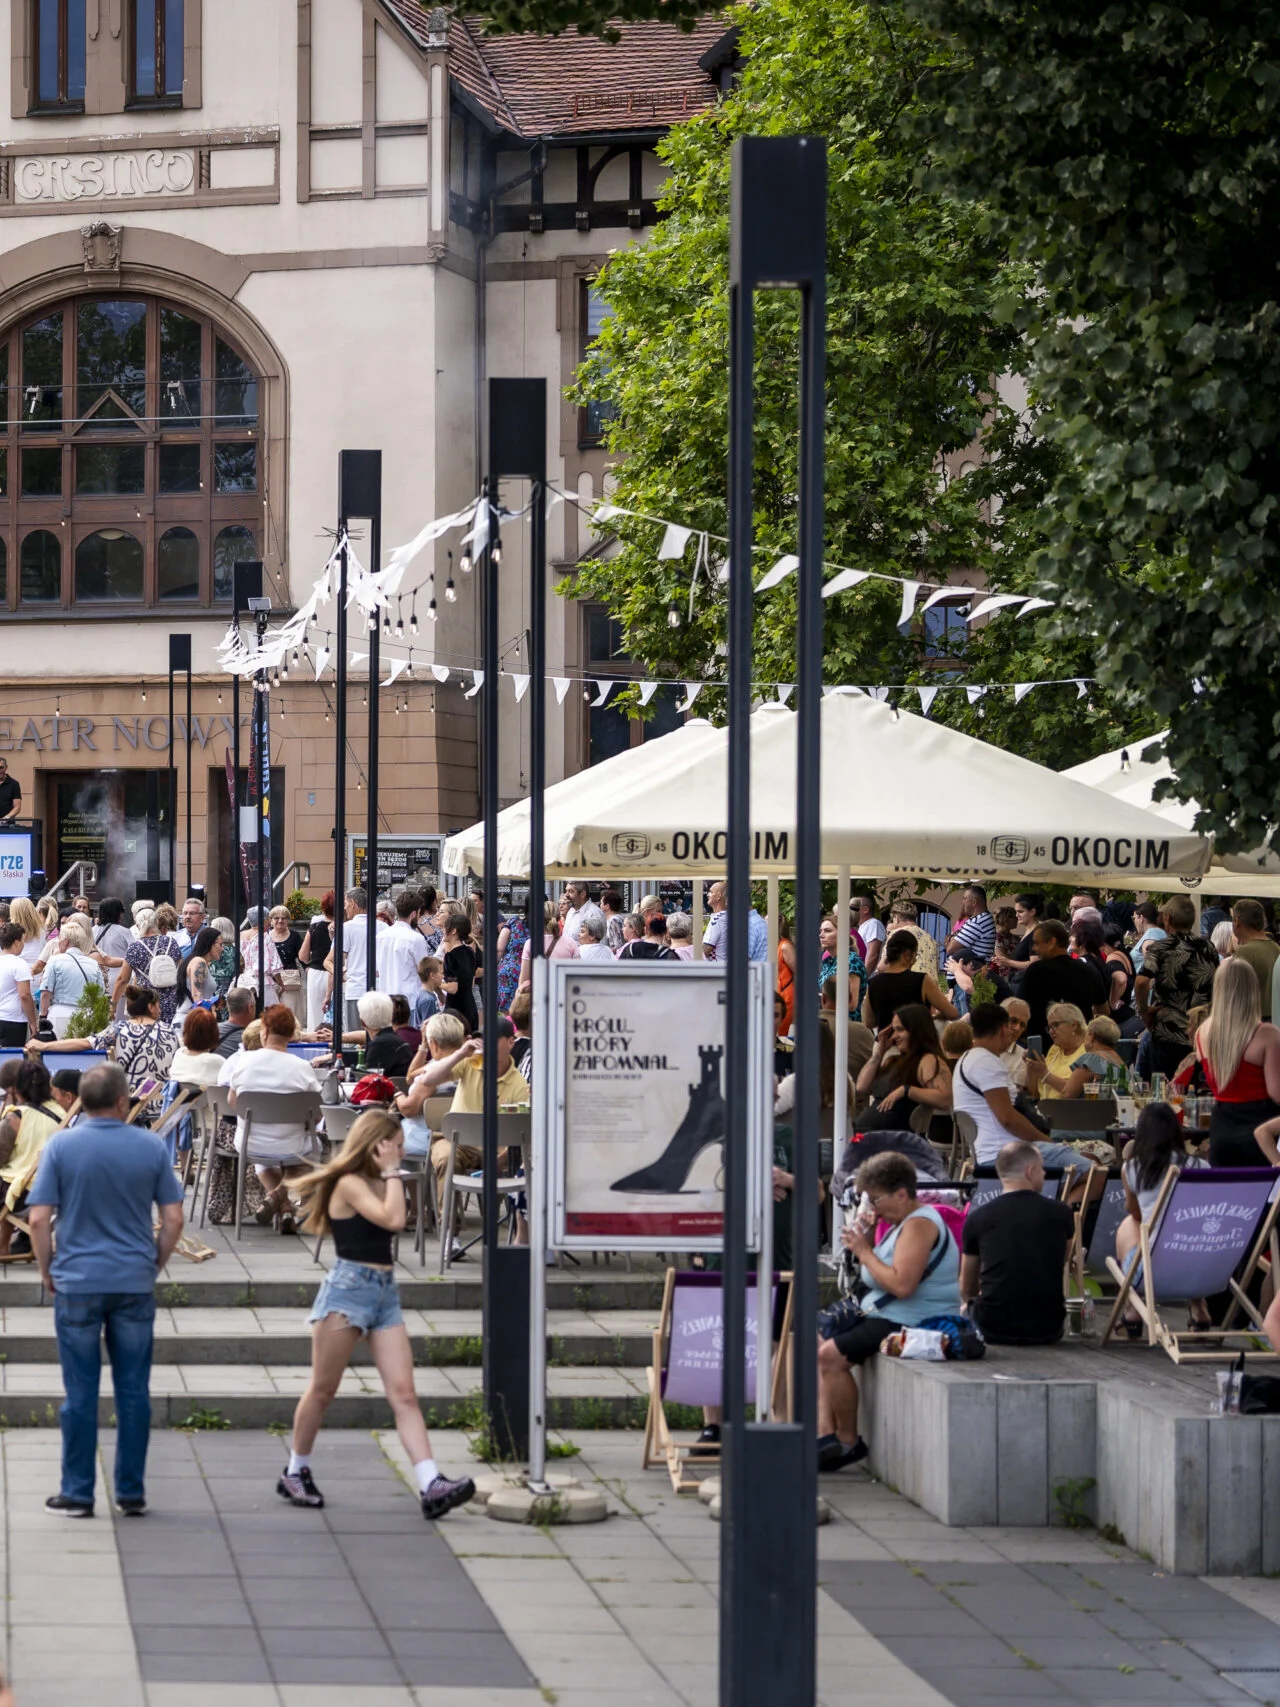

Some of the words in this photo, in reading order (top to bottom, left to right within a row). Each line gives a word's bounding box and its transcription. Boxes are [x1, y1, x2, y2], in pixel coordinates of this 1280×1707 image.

[14, 149, 194, 200] CASINO
[112, 715, 251, 751] NOWY
[598, 842, 608, 853] 18
[654, 842, 666, 852] 45
[672, 831, 788, 860] OKOIM
[976, 844, 986, 856] 18
[1033, 846, 1046, 857] 45
[1051, 836, 1169, 870] OKOCIM
[2, 869, 24, 878] Śląska
[572, 999, 587, 1015] O
[573, 1034, 632, 1052] KTÓRY
